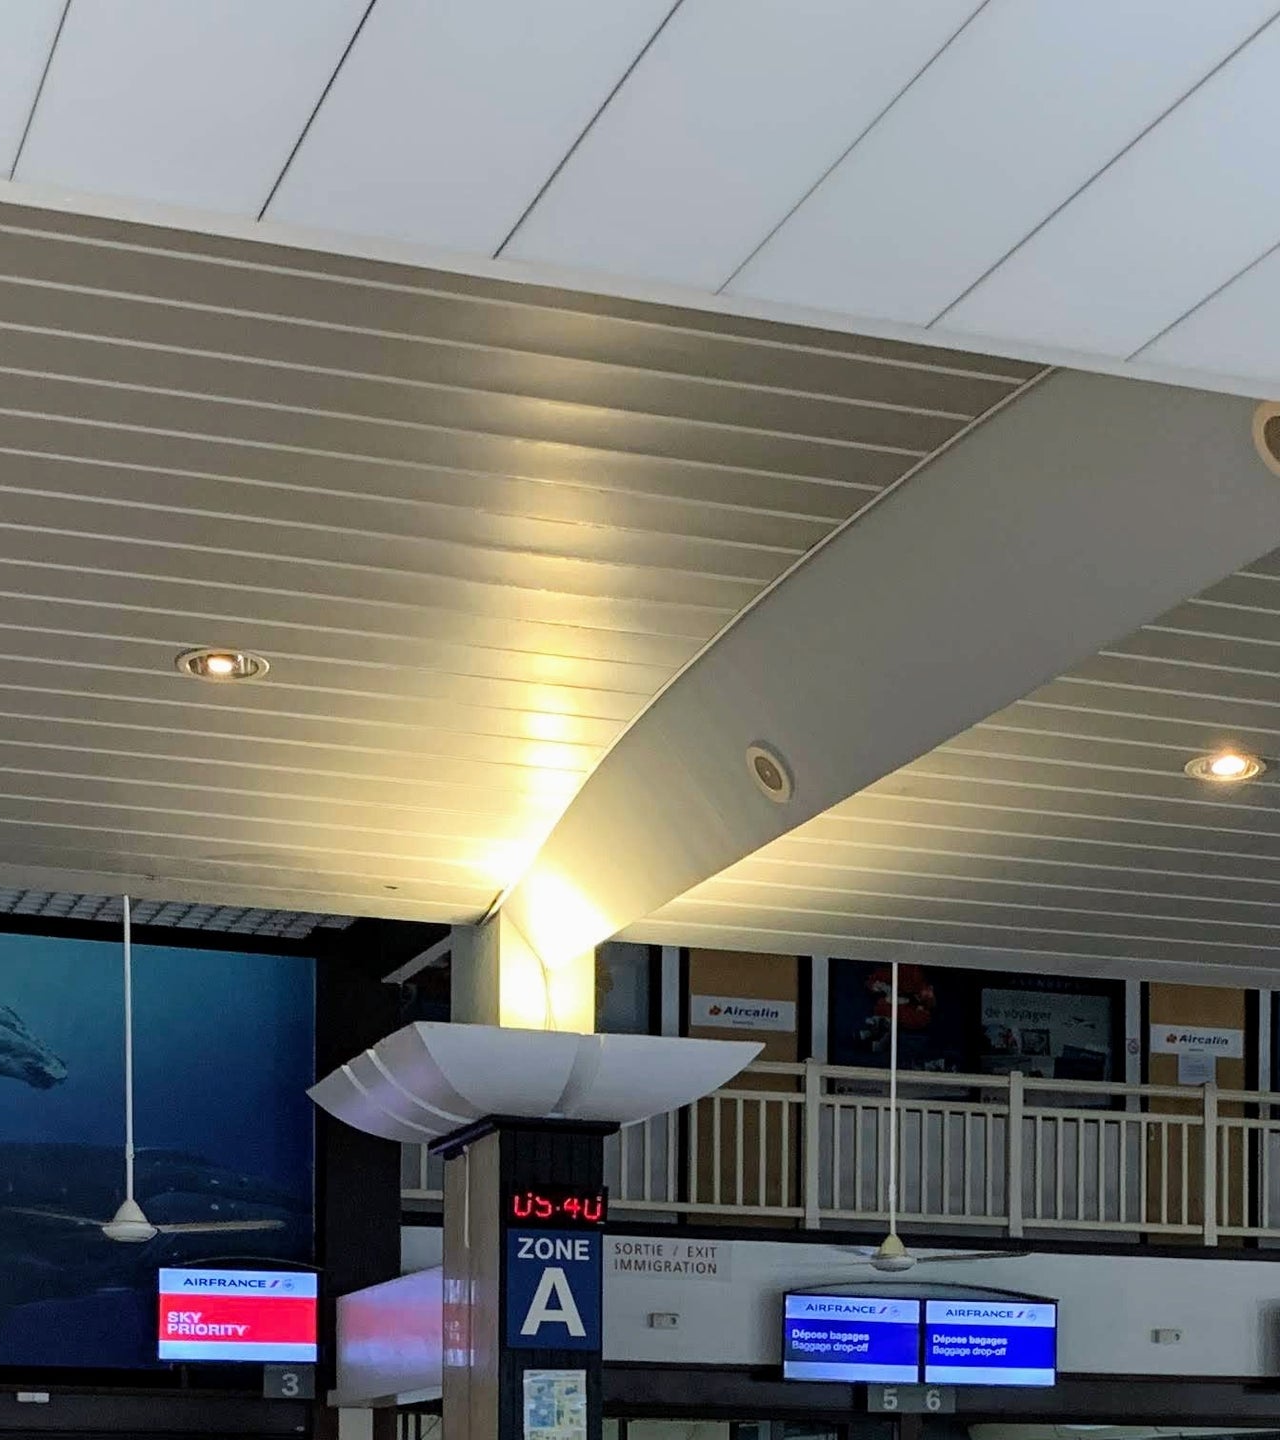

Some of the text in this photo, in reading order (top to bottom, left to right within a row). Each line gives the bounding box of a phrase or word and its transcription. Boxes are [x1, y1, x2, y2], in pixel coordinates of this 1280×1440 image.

[723, 1005, 779, 1018] Aircalin
[1179, 1034, 1229, 1045] Aircalin
[517, 1237, 590, 1261] ZONE
[614, 1242, 664, 1257] SORTIE
[687, 1246, 718, 1259] EXIT
[614, 1258, 718, 1275] IMMIGRATION
[183, 1278, 266, 1288] AIRFRANCE
[520, 1267, 587, 1337] A
[805, 1303, 876, 1314] AIRFRANCE
[167, 1311, 202, 1323] SKY
[946, 1309, 1013, 1318] AIRFRANCE
[167, 1323, 247, 1336] PRIORITY
[792, 1340, 869, 1353] Baggage drop-off
[933, 1345, 1007, 1356] Baggage drop-off
[281, 1373, 299, 1397] 3
[883, 1388, 941, 1411] 5 6
